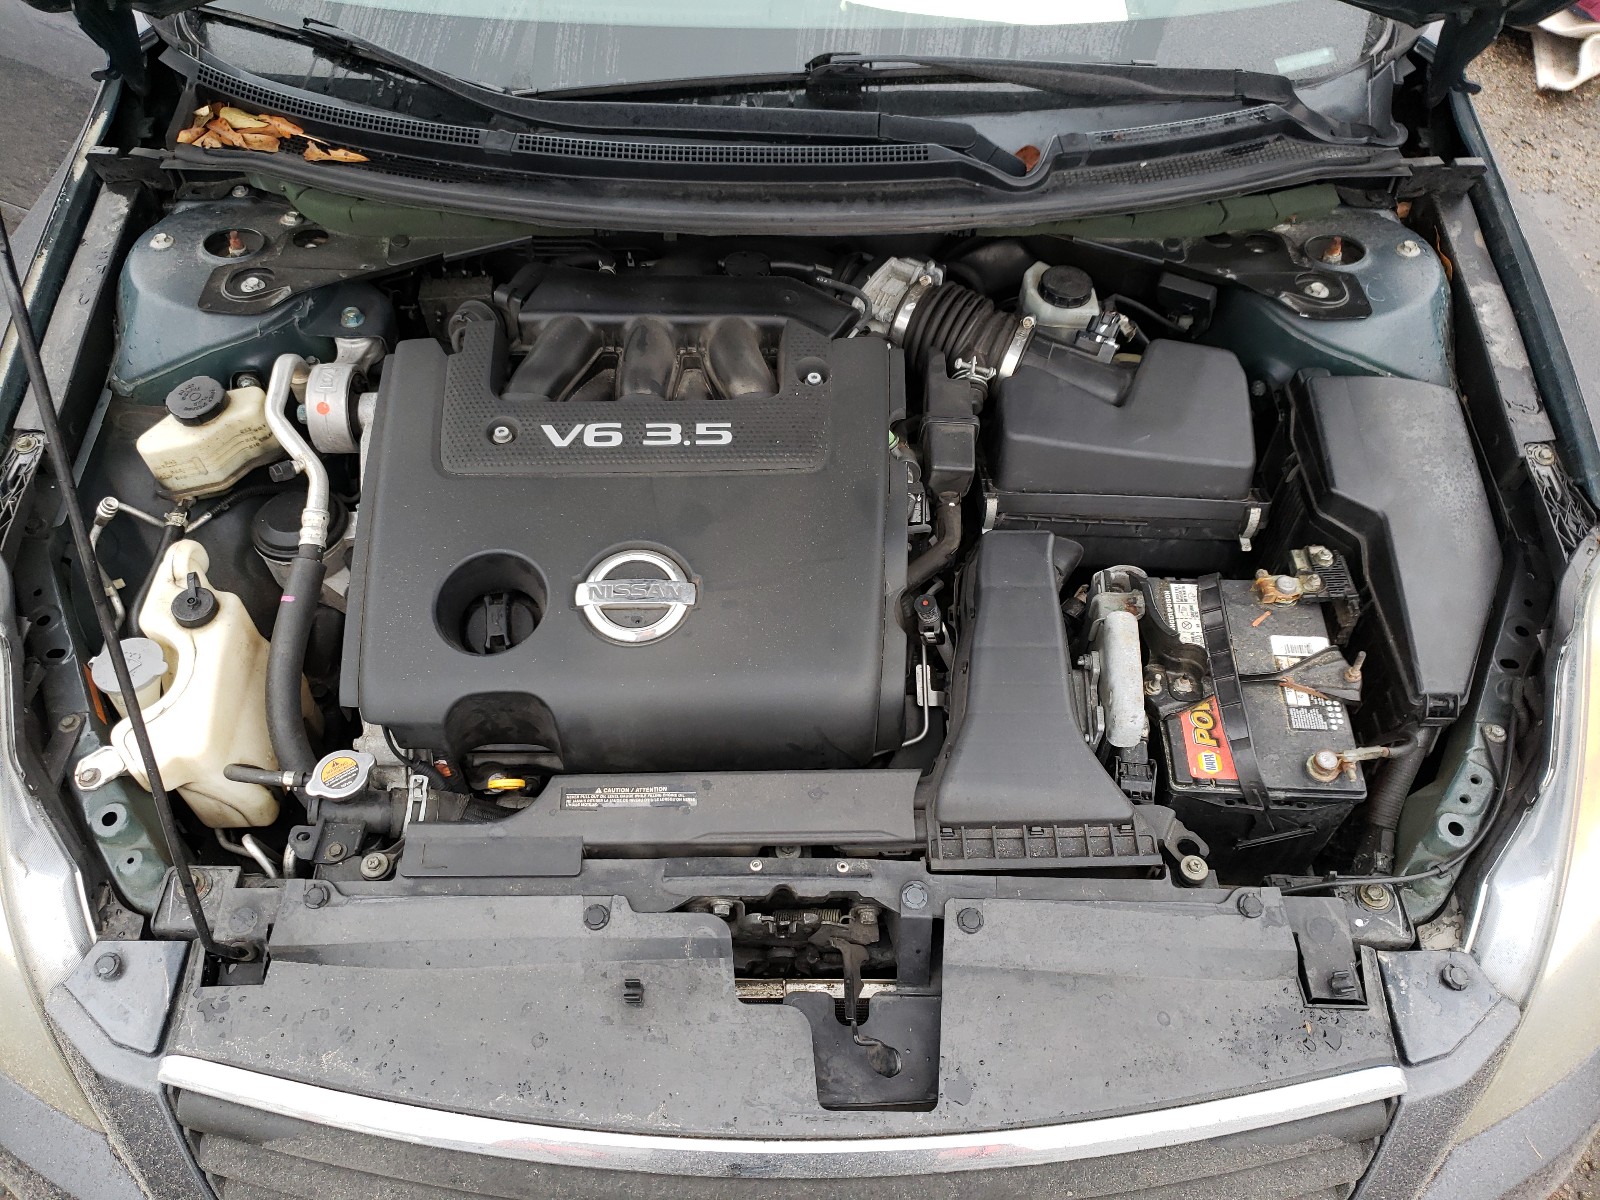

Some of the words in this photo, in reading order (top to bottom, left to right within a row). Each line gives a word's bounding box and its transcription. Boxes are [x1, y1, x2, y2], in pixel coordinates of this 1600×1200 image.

[541, 423, 622, 446] V6
[643, 423, 732, 446] 3.5
[589, 583, 682, 599] NISSAN
[1204, 754, 1217, 771] NAPA
